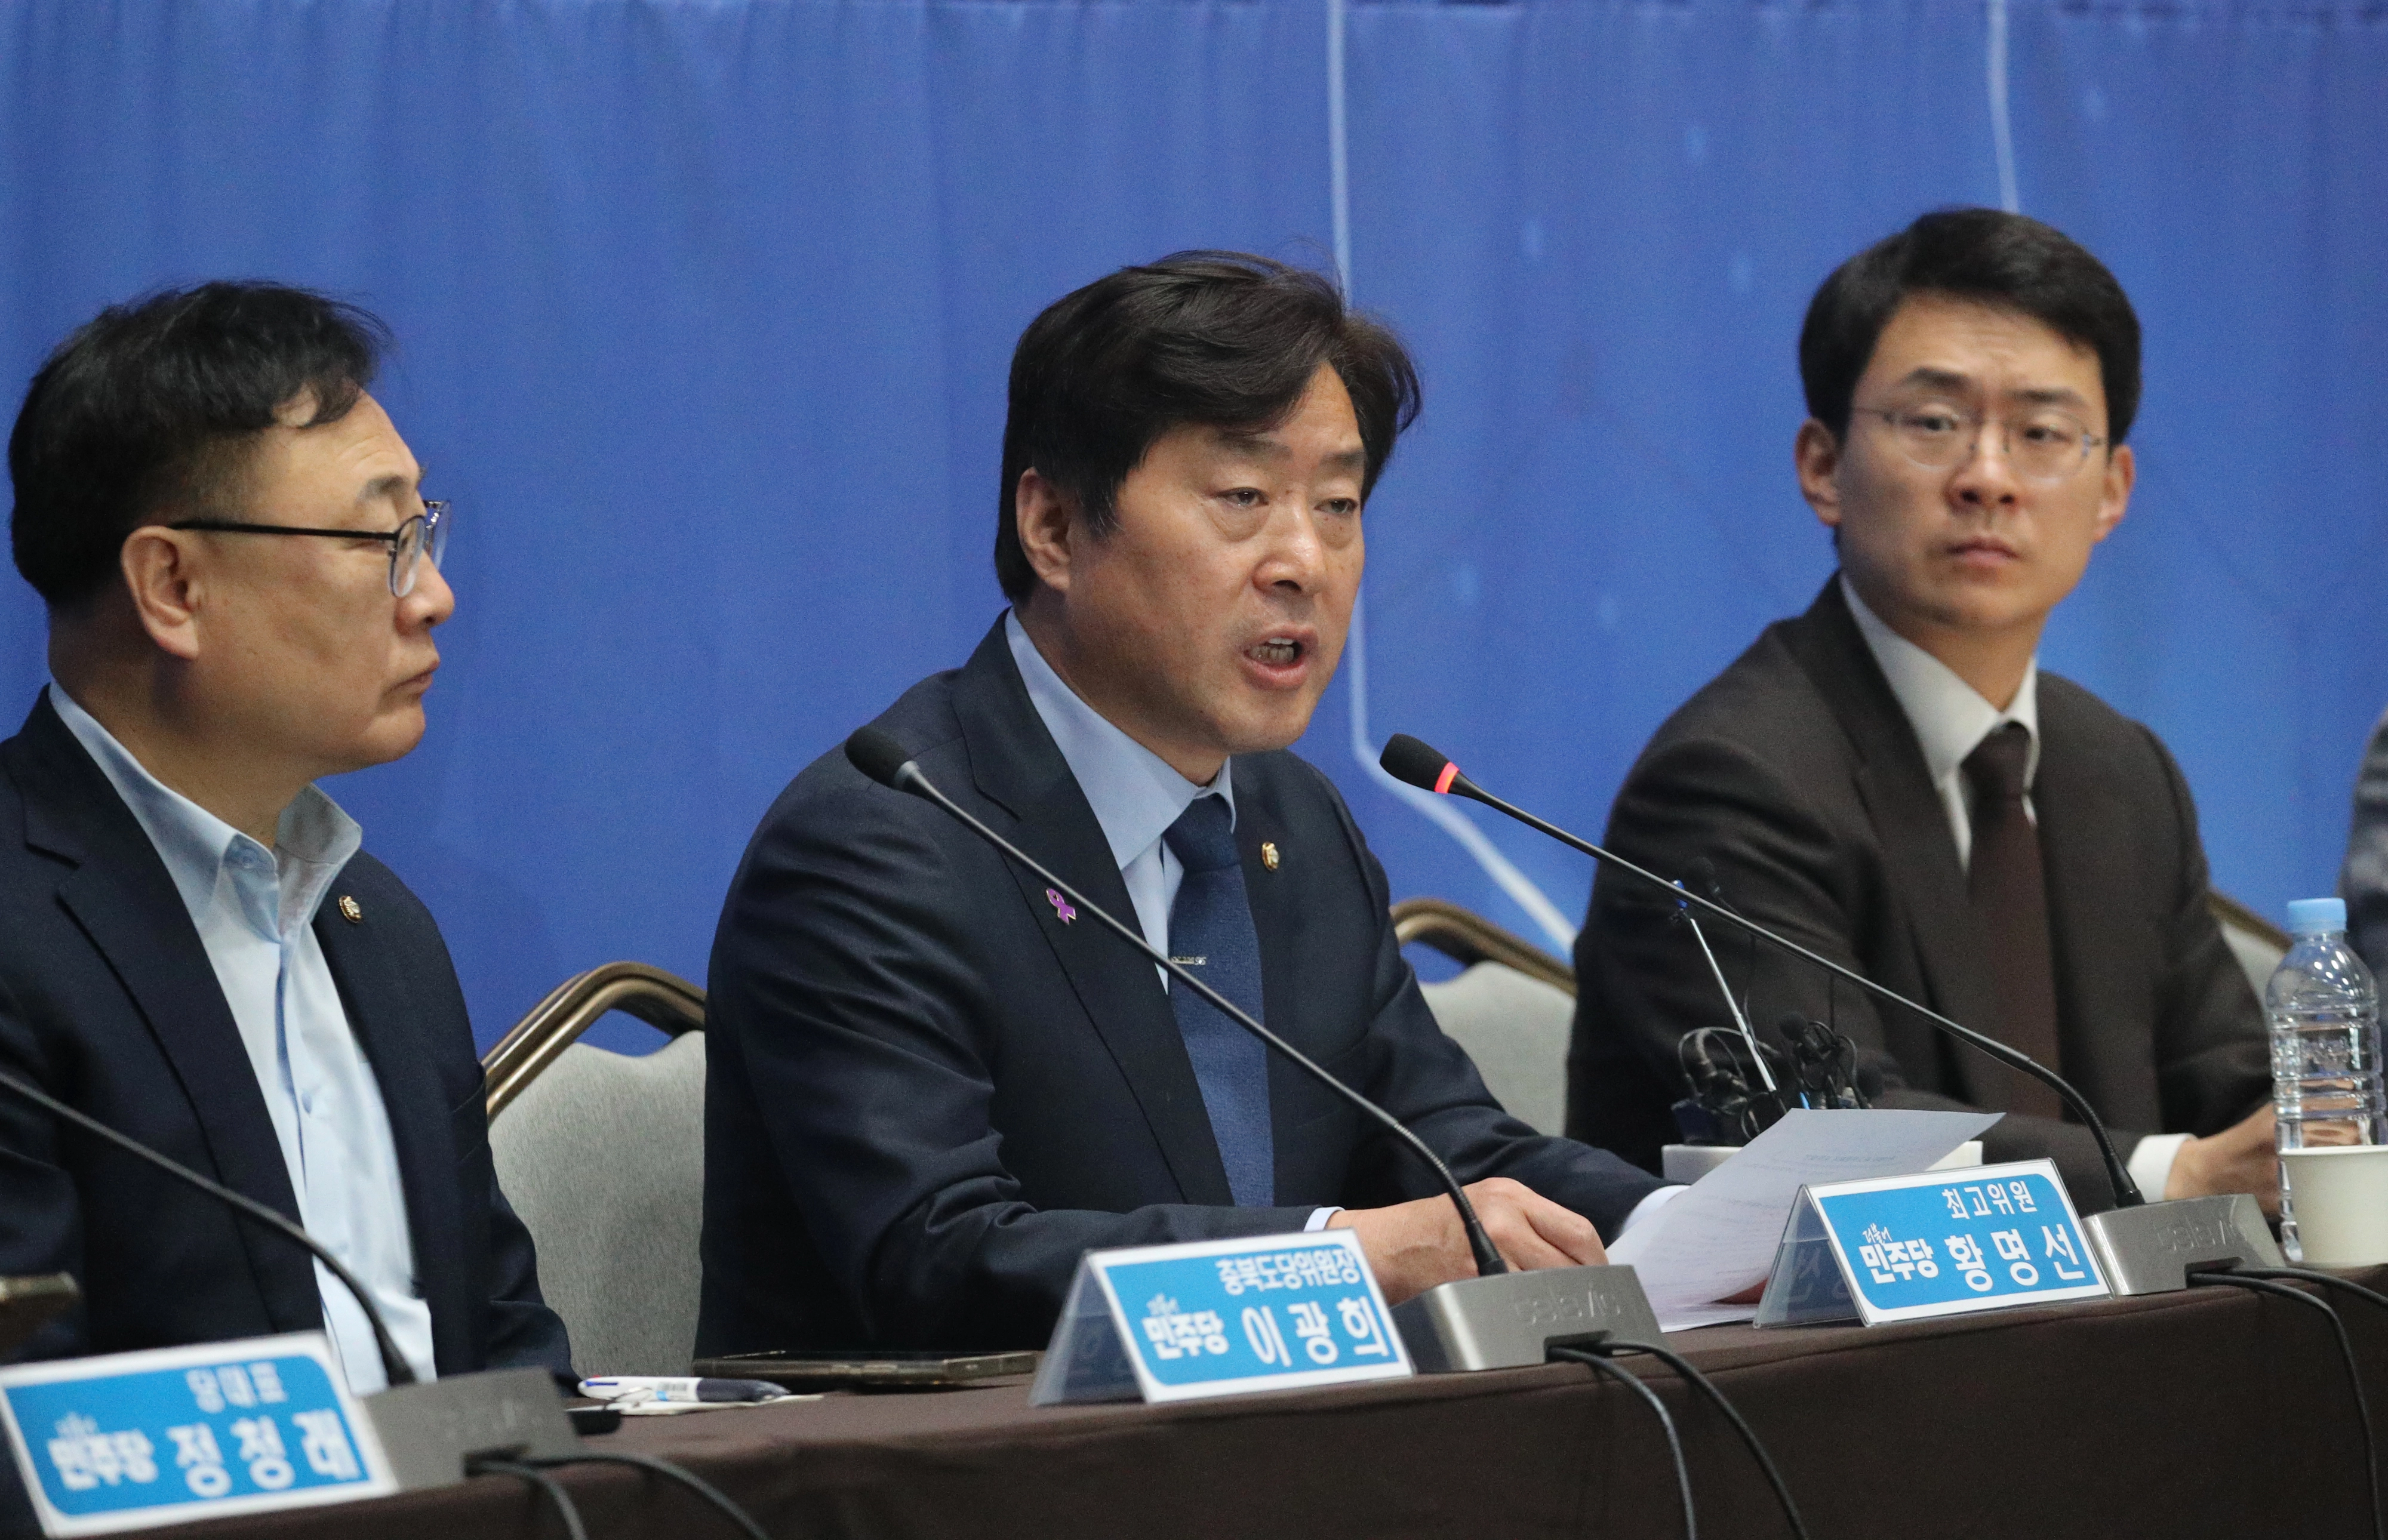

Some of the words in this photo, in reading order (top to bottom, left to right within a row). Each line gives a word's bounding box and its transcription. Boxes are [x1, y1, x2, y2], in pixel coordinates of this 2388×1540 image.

[1941, 1181, 2038, 1219] 최고위원
[1862, 1222, 1893, 1245] 더불어
[1944, 1224, 2085, 1292] 황명선
[1215, 1249, 1361, 1296] 충북도당위원장
[1858, 1239, 1939, 1284] 민주당
[1141, 1309, 1230, 1360] 민주당
[1241, 1296, 1390, 1367] 이광희
[47, 1429, 159, 1491] 민주당
[166, 1408, 361, 1498] 정청래
